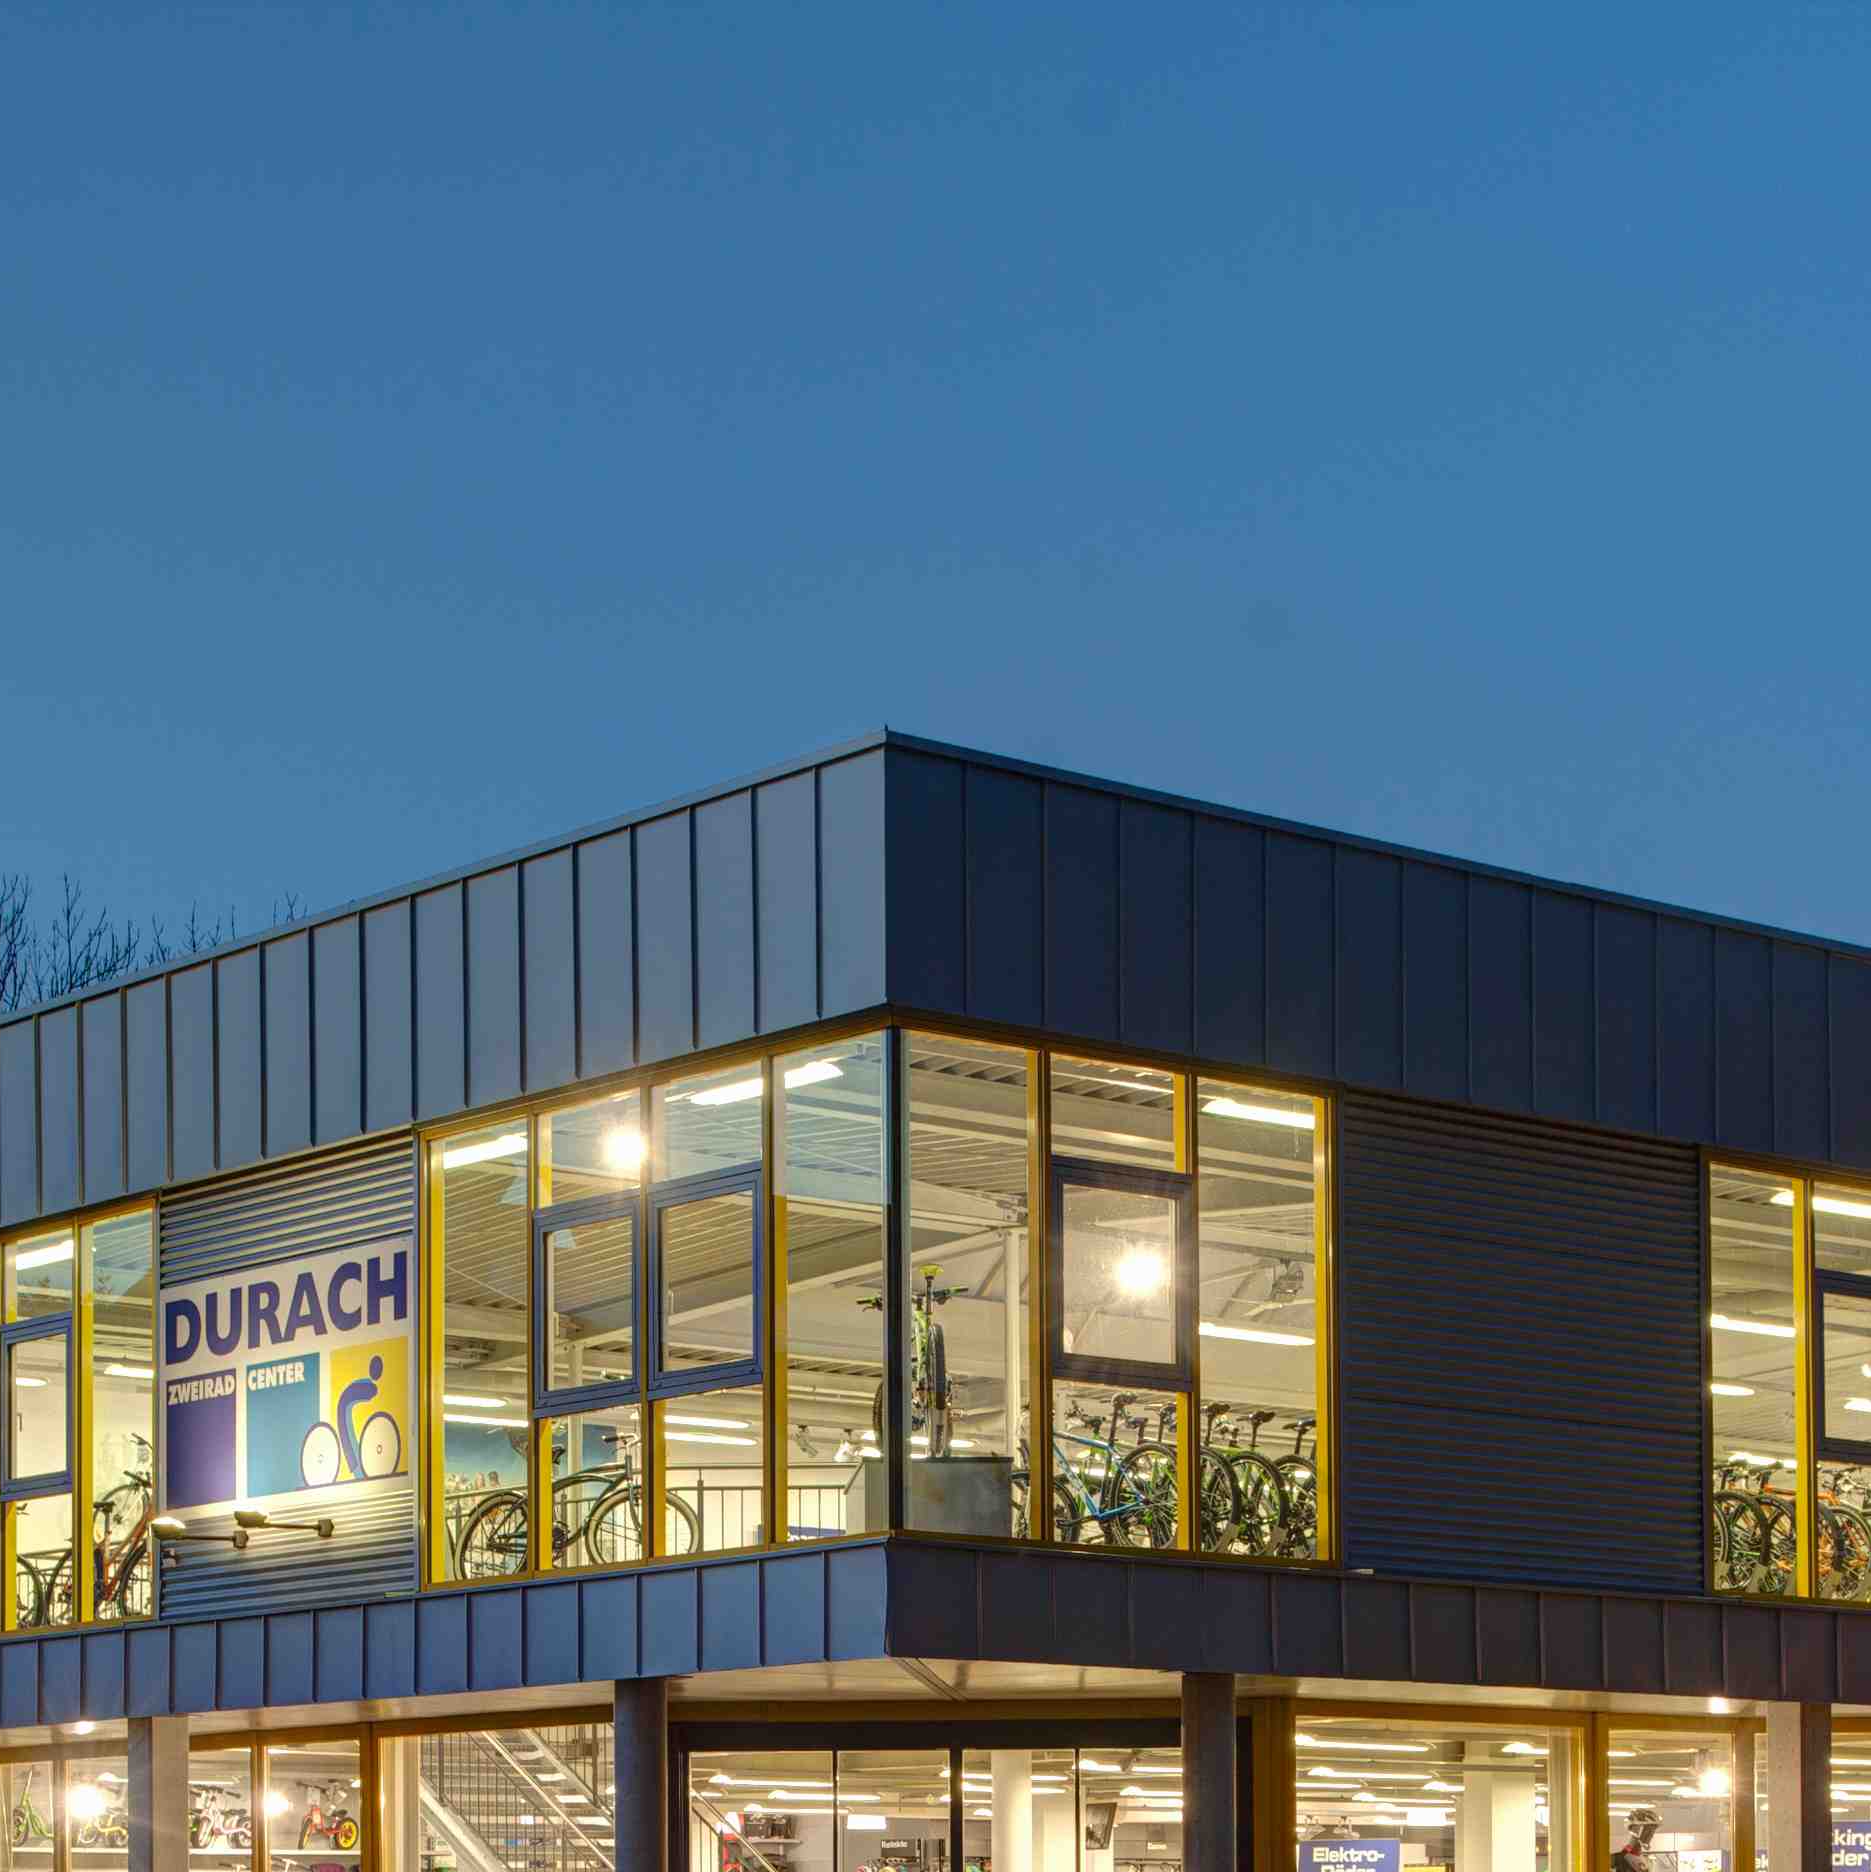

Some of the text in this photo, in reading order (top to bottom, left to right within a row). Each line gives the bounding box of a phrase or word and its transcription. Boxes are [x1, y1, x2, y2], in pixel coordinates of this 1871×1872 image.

[165, 1251, 408, 1366] DURACH
[167, 1361, 305, 1406] ZWEIRAD CENTER
[1312, 1847, 1385, 1863] Elektro-
